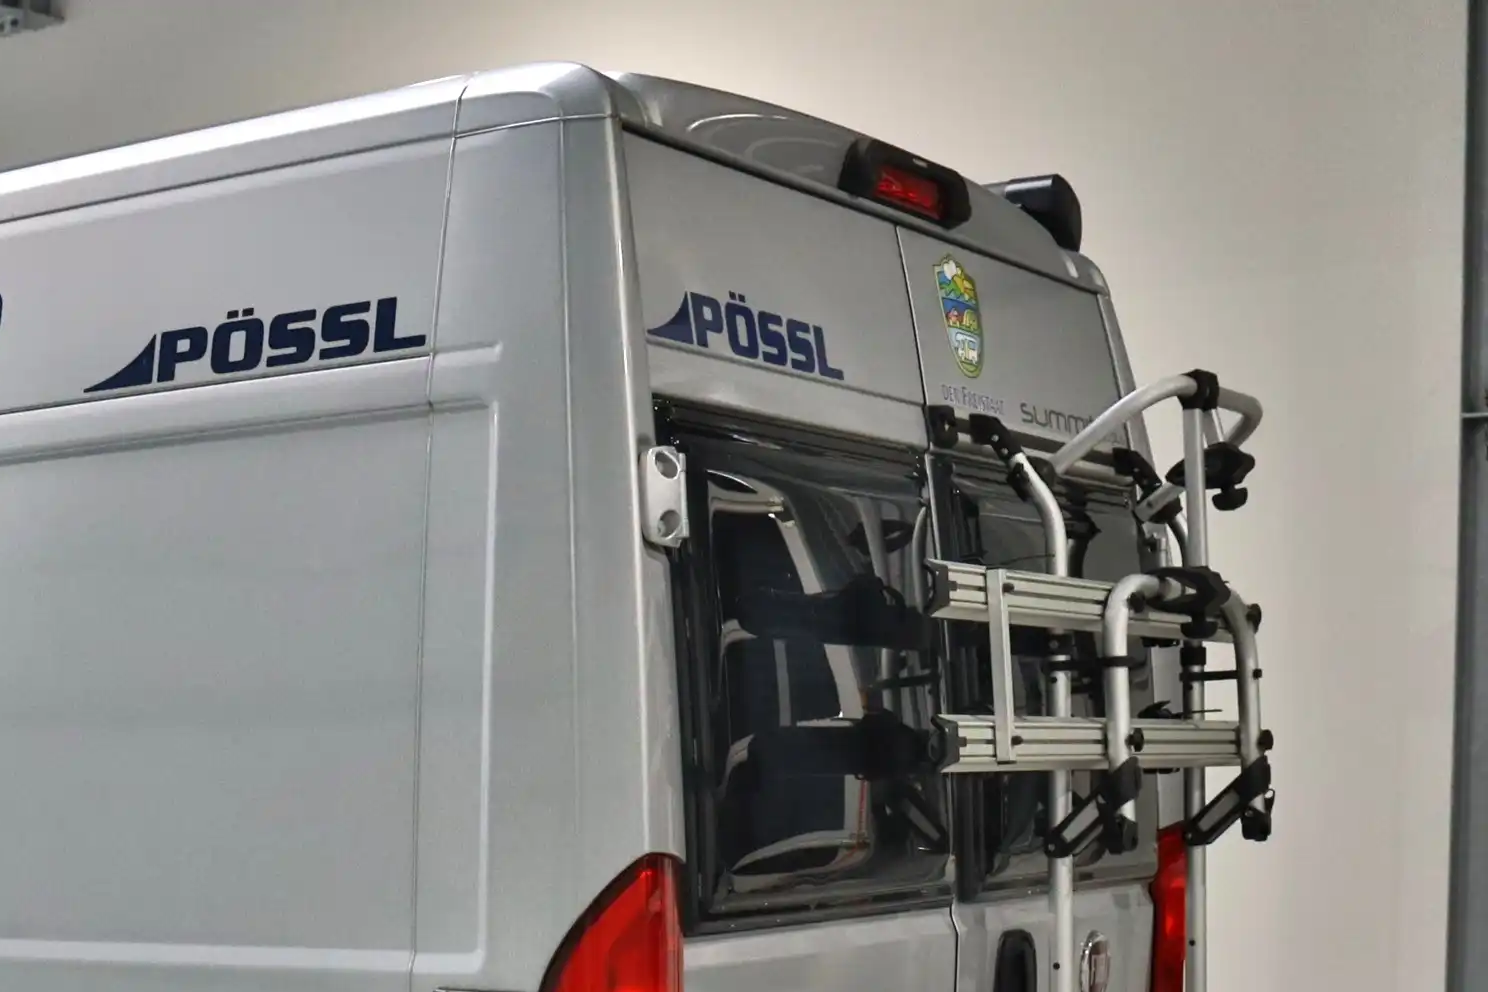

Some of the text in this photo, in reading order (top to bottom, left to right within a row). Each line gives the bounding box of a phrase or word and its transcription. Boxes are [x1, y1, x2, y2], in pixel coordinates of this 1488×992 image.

[157, 296, 427, 383] PÖSSL
[692, 290, 844, 381] PÖSSL
[1020, 402, 1096, 435] summ
